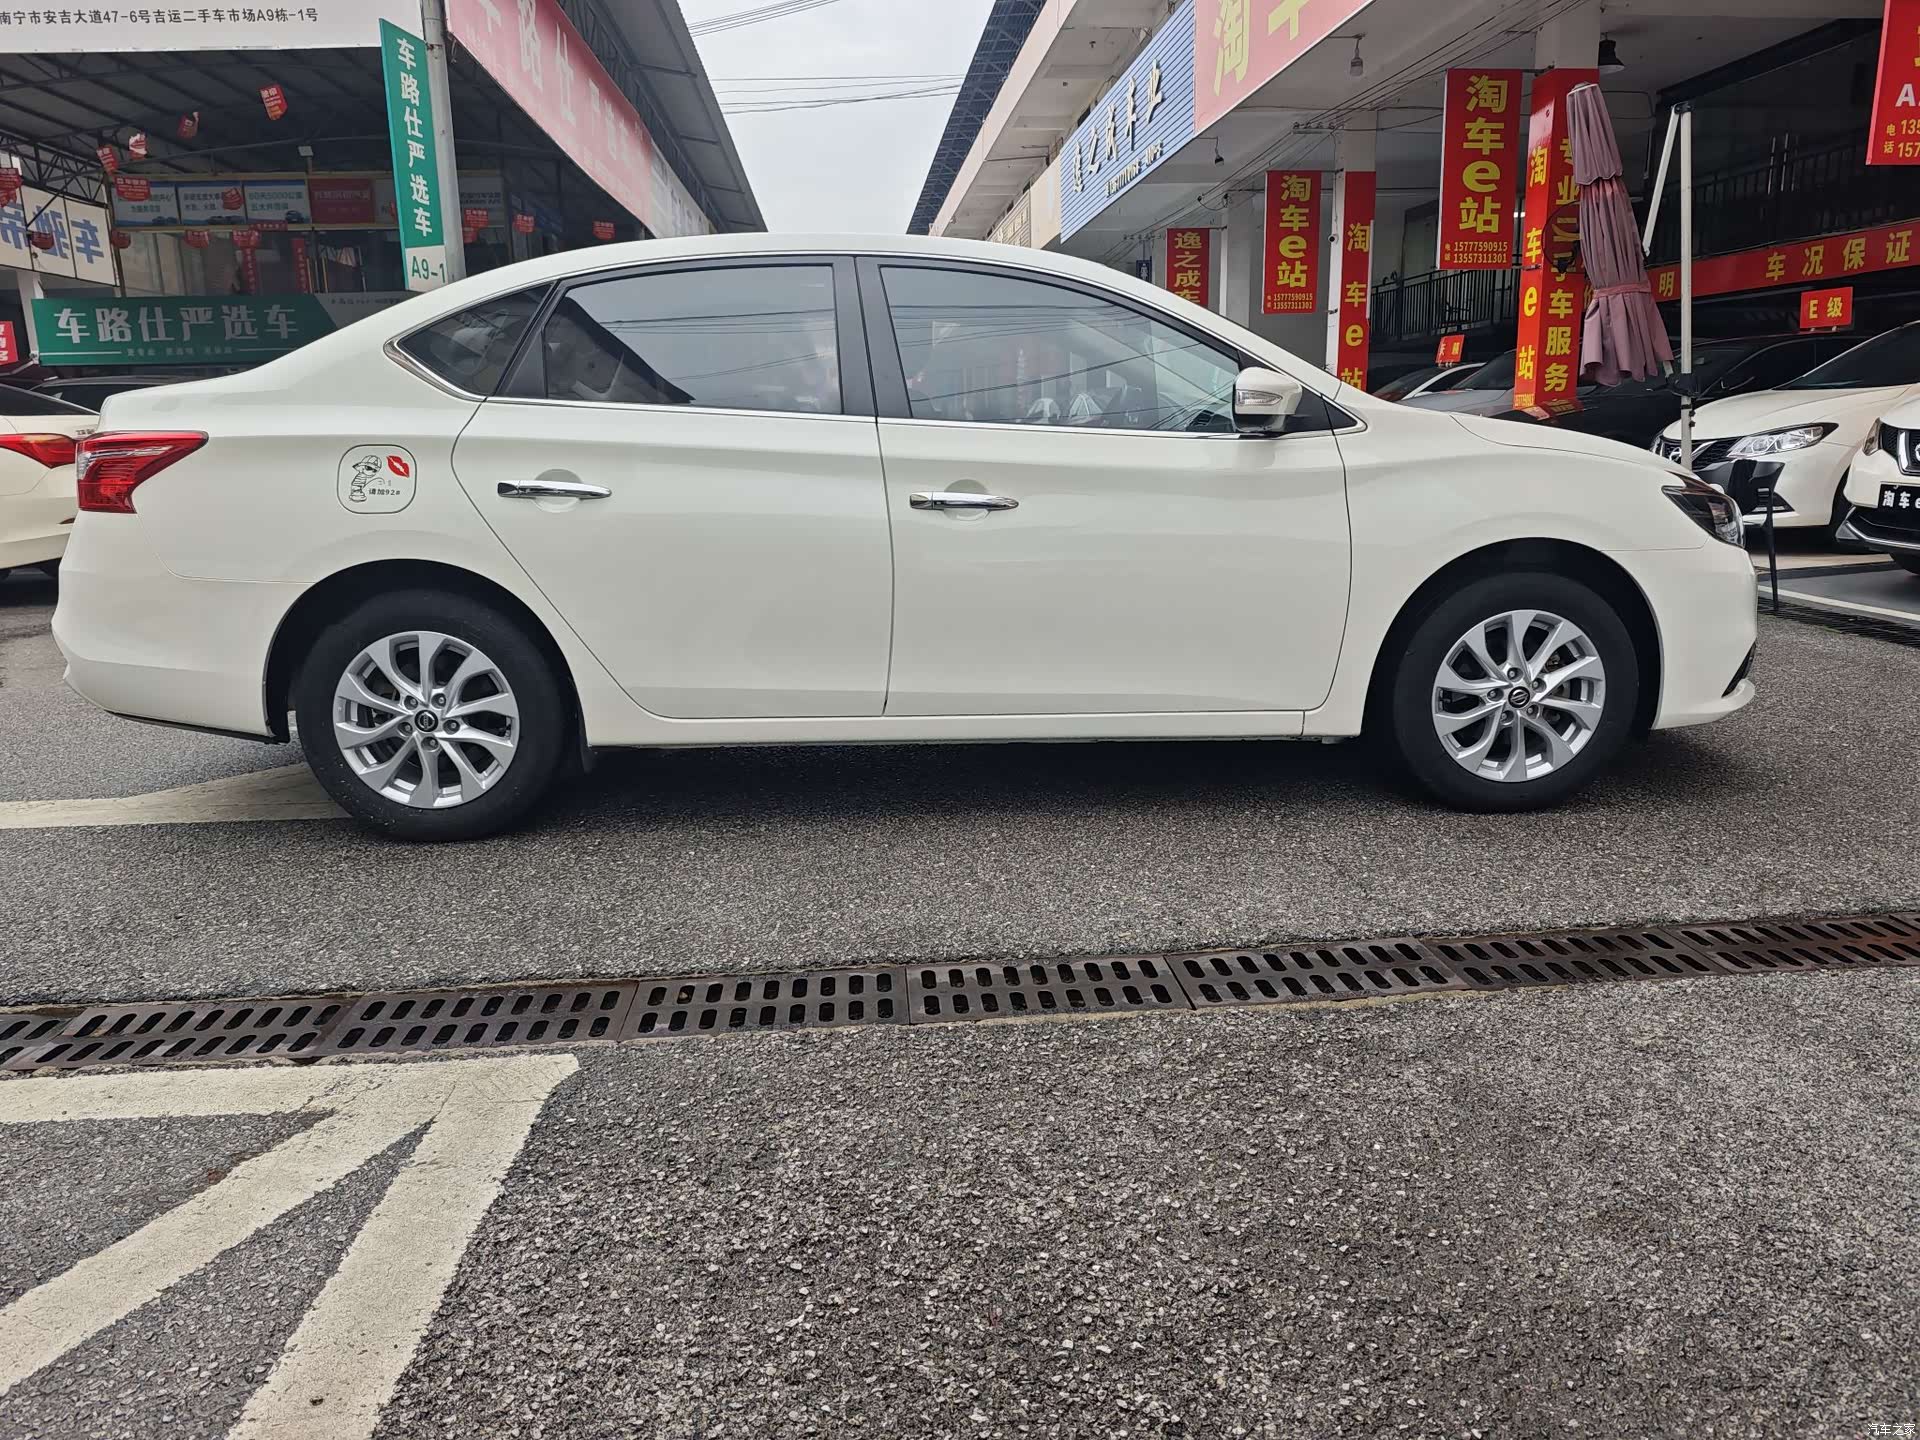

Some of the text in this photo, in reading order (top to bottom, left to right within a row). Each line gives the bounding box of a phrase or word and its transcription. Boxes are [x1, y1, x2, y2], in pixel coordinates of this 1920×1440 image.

[0, 9, 318, 24] 南宁市安吉大道47-6号吉运二手车市场A9栋-1号
[396, 38, 432, 237] 车路仕严选车
[1459, 75, 1508, 233] 淘车e站
[1277, 175, 1311, 287] 淘车e站
[1454, 242, 1508, 251] 15777590915
[411, 256, 446, 284] A9-1
[1453, 253, 1507, 263] 13557311301
[1518, 145, 1547, 380] 淘车e站
[1765, 230, 1912, 281] 车况保证
[54, 305, 300, 344] 车路仕严选车
[1809, 297, 1843, 318] E 级
